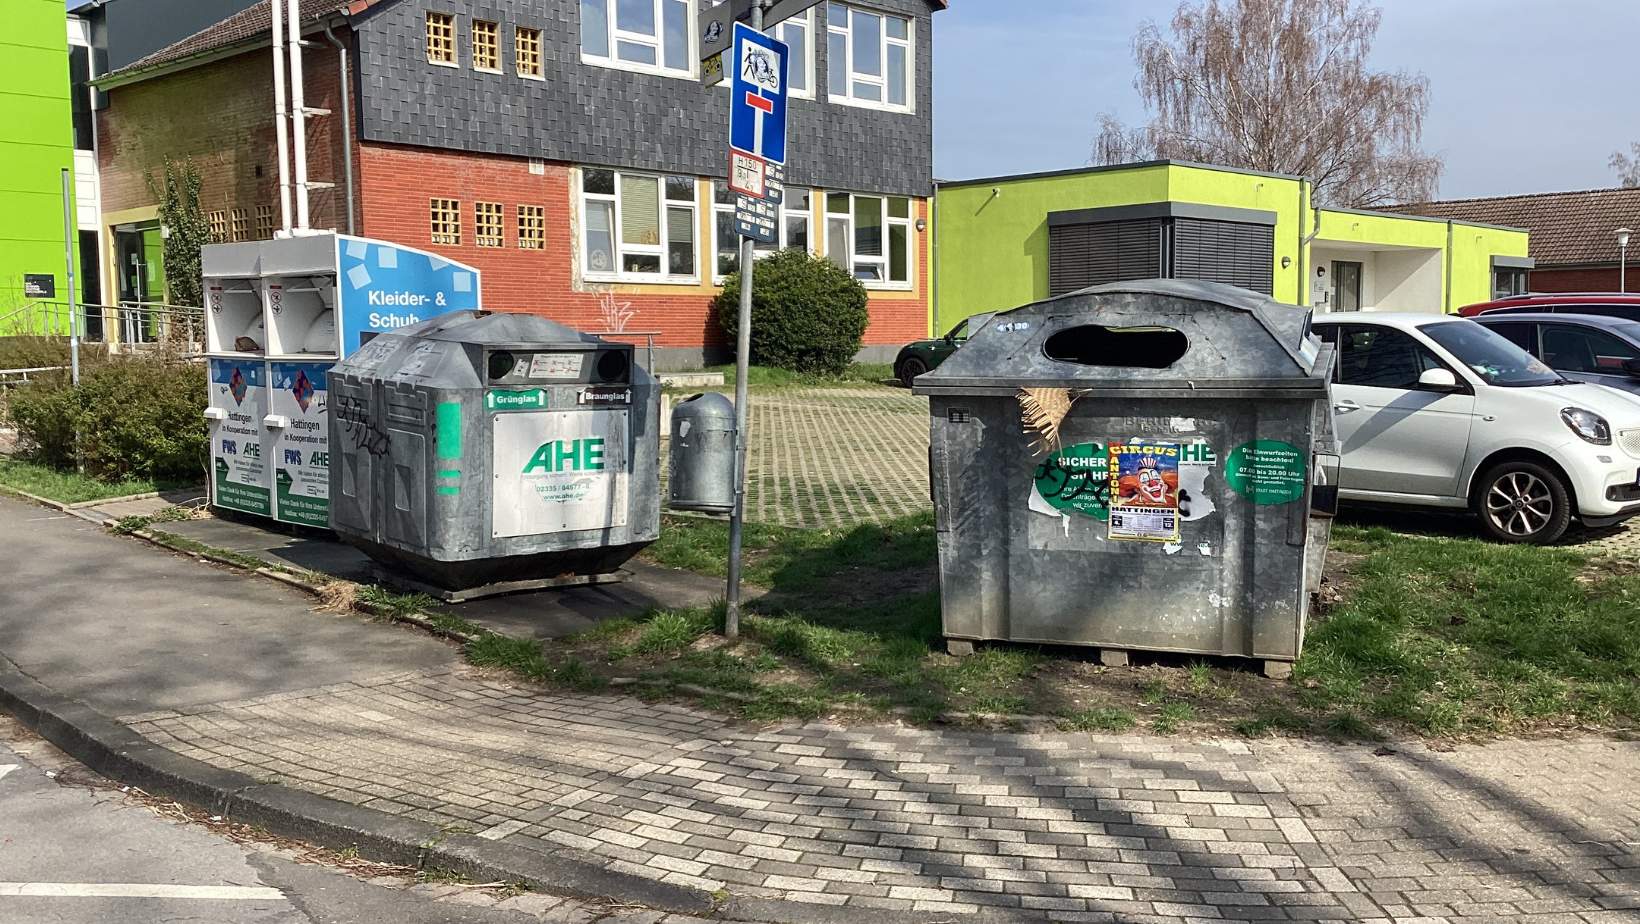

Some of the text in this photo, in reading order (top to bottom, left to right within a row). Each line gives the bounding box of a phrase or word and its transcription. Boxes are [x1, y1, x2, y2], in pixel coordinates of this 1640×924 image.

[368, 290, 446, 306] Kleider- &
[496, 394, 536, 404] Grünglas
[586, 392, 624, 400] Braunglas
[227, 425, 250, 435] Kooperation
[290, 418, 319, 432] Hattingen
[289, 434, 318, 444] Kooperation
[222, 439, 237, 455] FWS
[243, 442, 260, 457] AHE
[1110, 446, 1178, 456] CIRCUS
[284, 449, 301, 465] FWS
[522, 438, 604, 473] AHE
[1058, 457, 1107, 467] SICHER
